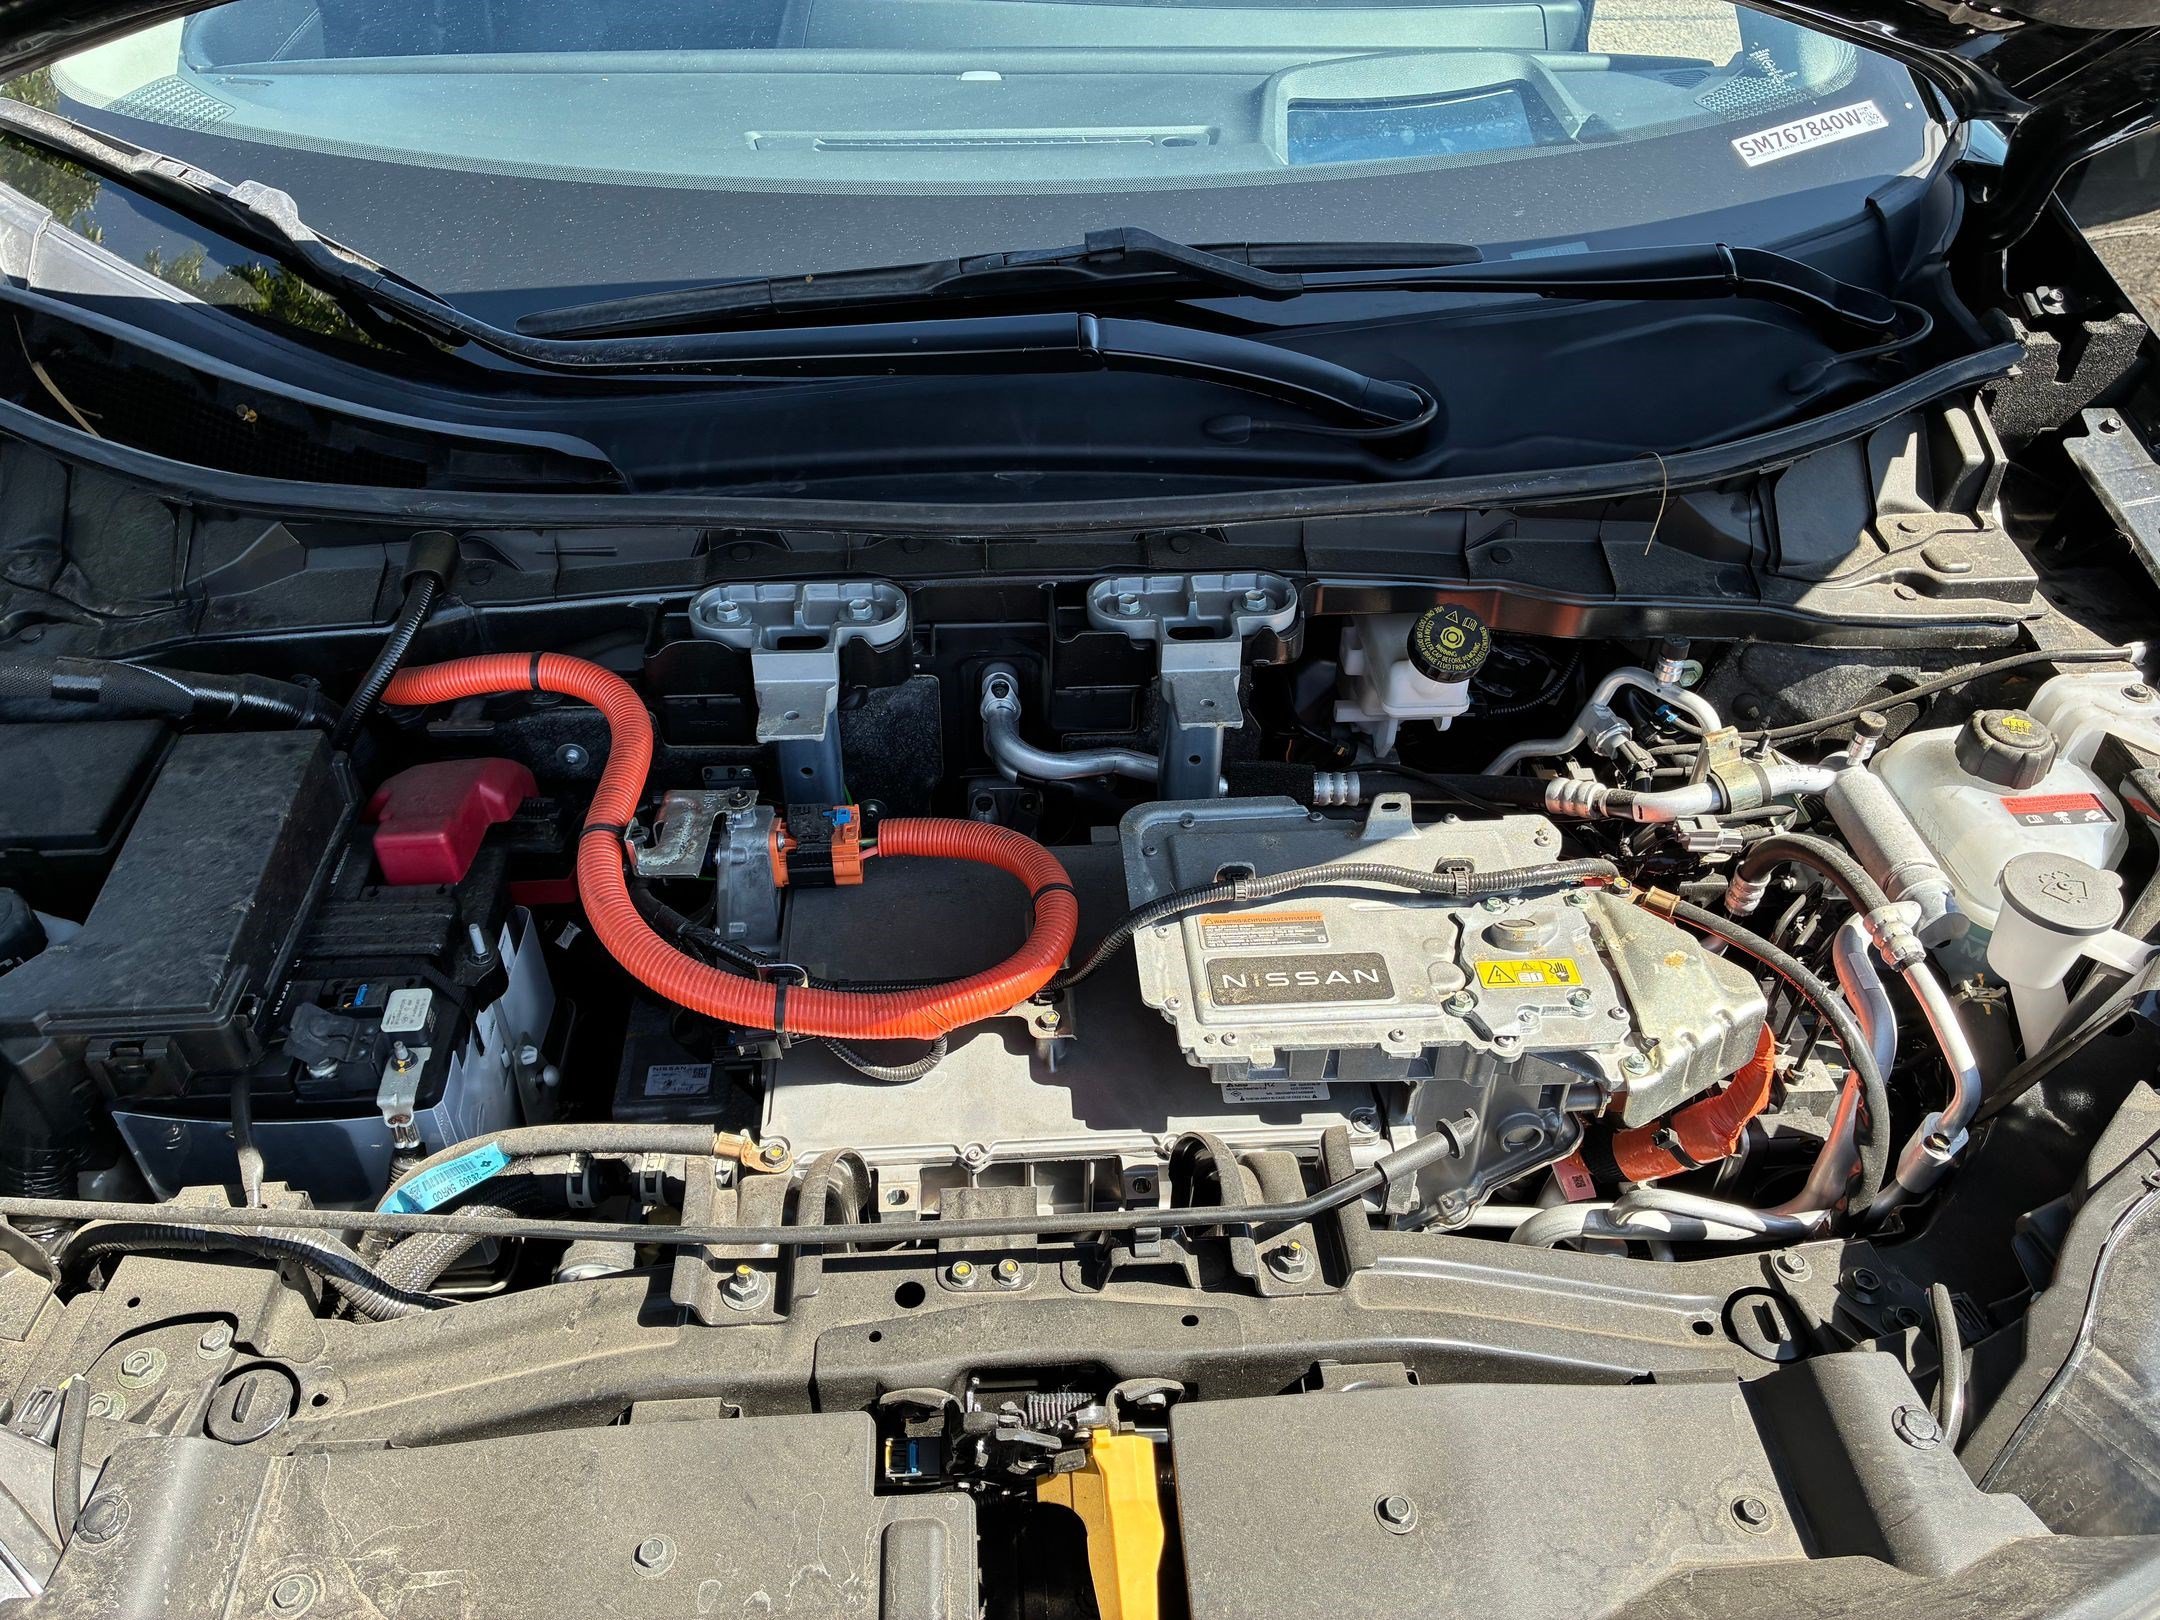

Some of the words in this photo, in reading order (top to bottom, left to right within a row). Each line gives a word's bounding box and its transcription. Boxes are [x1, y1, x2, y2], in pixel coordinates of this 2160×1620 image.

[1739, 108, 1862, 157] SM767840W
[1432, 649, 1442, 658] CAP
[1221, 968, 1380, 989] NISSAN
[460, 1173, 482, 1188] 28360
